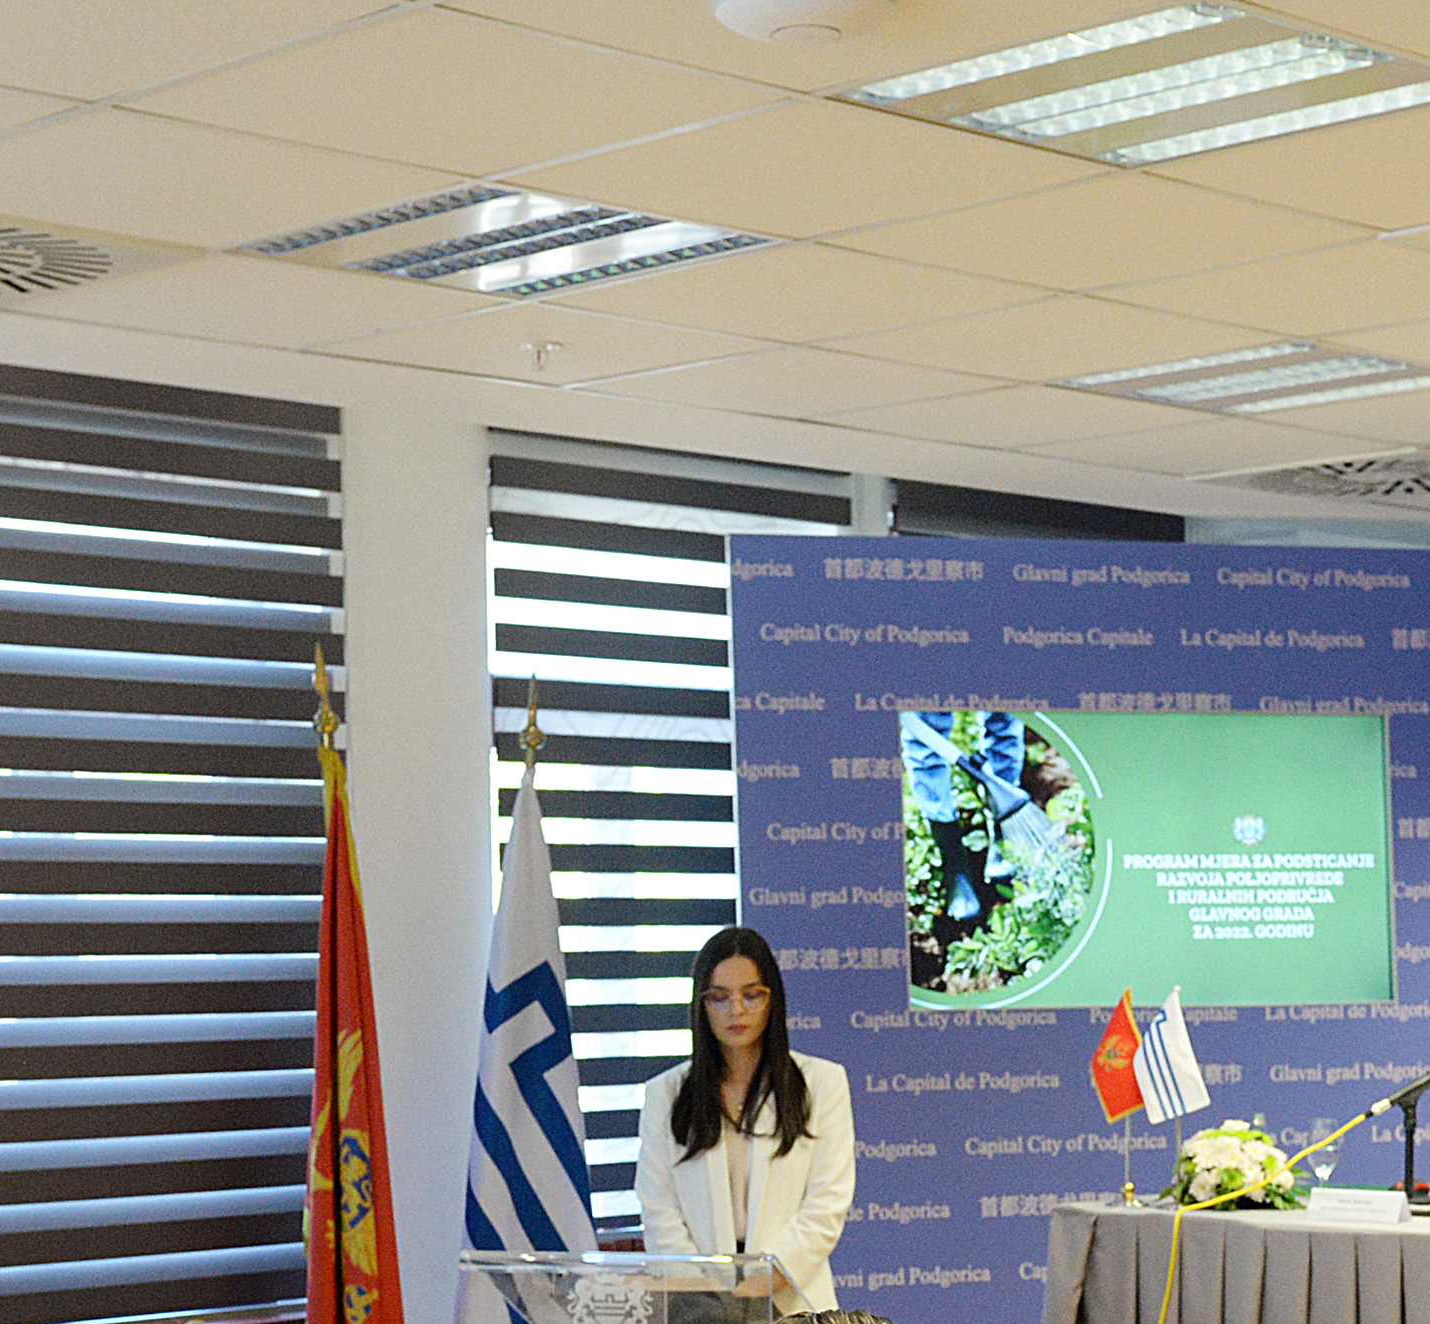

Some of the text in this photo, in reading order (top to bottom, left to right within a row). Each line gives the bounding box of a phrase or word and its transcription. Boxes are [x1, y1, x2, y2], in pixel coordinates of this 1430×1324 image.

[732, 559, 793, 580] dgorica
[1013, 563, 1191, 588] Glavni grad Podgorica
[1217, 567, 1410, 591] Capital City of Podgorica
[760, 623, 970, 647] Capital City of Podgorica
[1003, 626, 1154, 650] Podgorica Capitale
[1180, 629, 1365, 652] La Capital de Podgorica
[755, 693, 825, 715] Capitale
[855, 693, 877, 711] La
[738, 760, 800, 782] dgorica
[767, 822, 827, 845] Capital
[831, 822, 866, 845] City
[871, 822, 892, 840] of
[1123, 853, 1375, 869] PROGRAM MJERA ZA PODSTICANJE
[1156, 872, 1225, 887] RAZVOJA
[749, 886, 904, 909] Glavni grad Podgo
[1177, 889, 1255, 904] RURALNIH
[1188, 906, 1315, 922] GLAVNOG GRADA
[1193, 925, 1214, 939] ZA
[1255, 924, 1315, 938] GODINU
[850, 1009, 1057, 1032] Capital City of Podgorica
[1186, 1007, 1238, 1026] apitale
[1265, 1006, 1285, 1021] La
[1288, 1005, 1343, 1023] Capital
[1347, 1004, 1367, 1020] de
[866, 1072, 1060, 1095] La Capital de Podgorica
[1270, 1063, 1322, 1082] Glavni
[1326, 1062, 1361, 1084] grad
[1372, 1125, 1392, 1143] La
[855, 1140, 937, 1162] Podgorica
[965, 1135, 1023, 1158] Capital
[1027, 1135, 1062, 1156] City
[1067, 1134, 1086, 1152] of
[868, 1201, 951, 1224] Podgorica
[868, 1267, 905, 1291] grad
[910, 1264, 992, 1288] Podgorica
